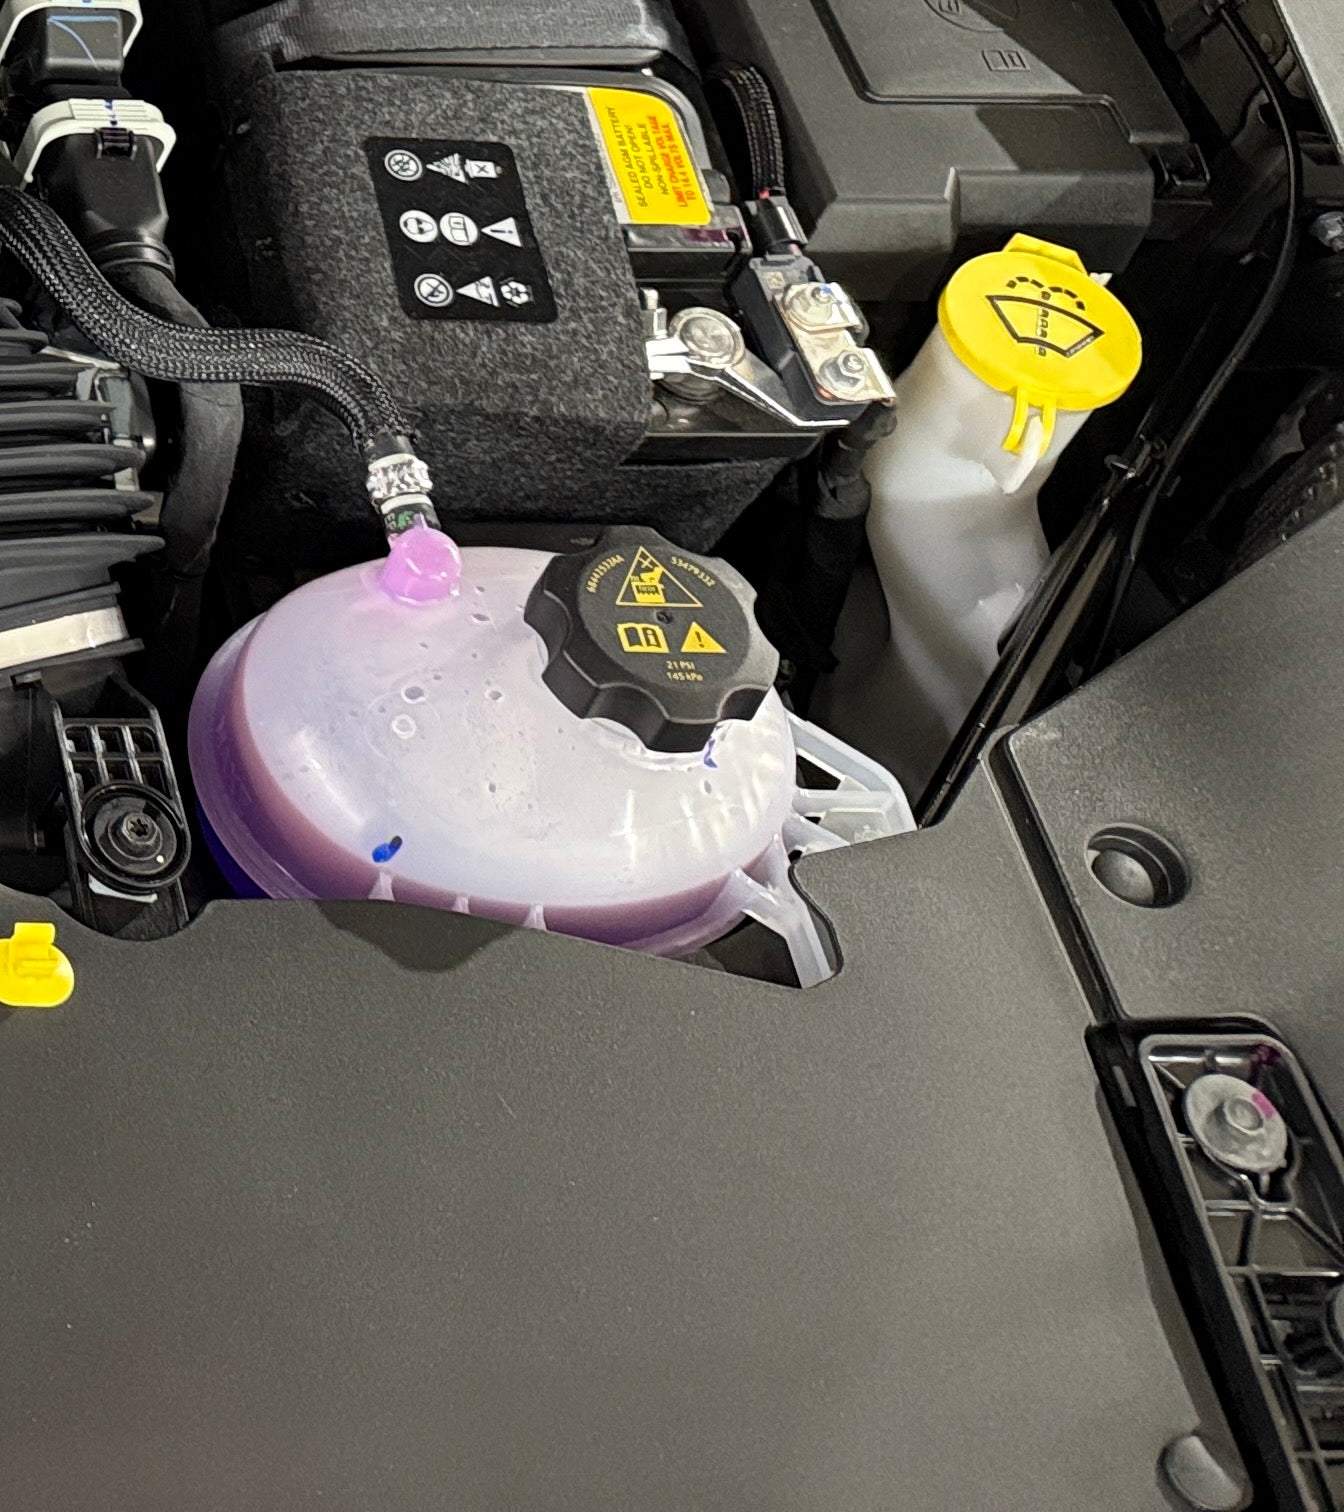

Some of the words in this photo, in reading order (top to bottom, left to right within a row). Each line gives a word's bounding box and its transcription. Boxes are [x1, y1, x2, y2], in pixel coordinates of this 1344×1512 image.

[605, 106, 626, 145] BATTERY
[619, 148, 634, 168] AGM
[633, 155, 647, 172] NOT
[627, 171, 648, 206] SEALED
[640, 176, 653, 188] DO
